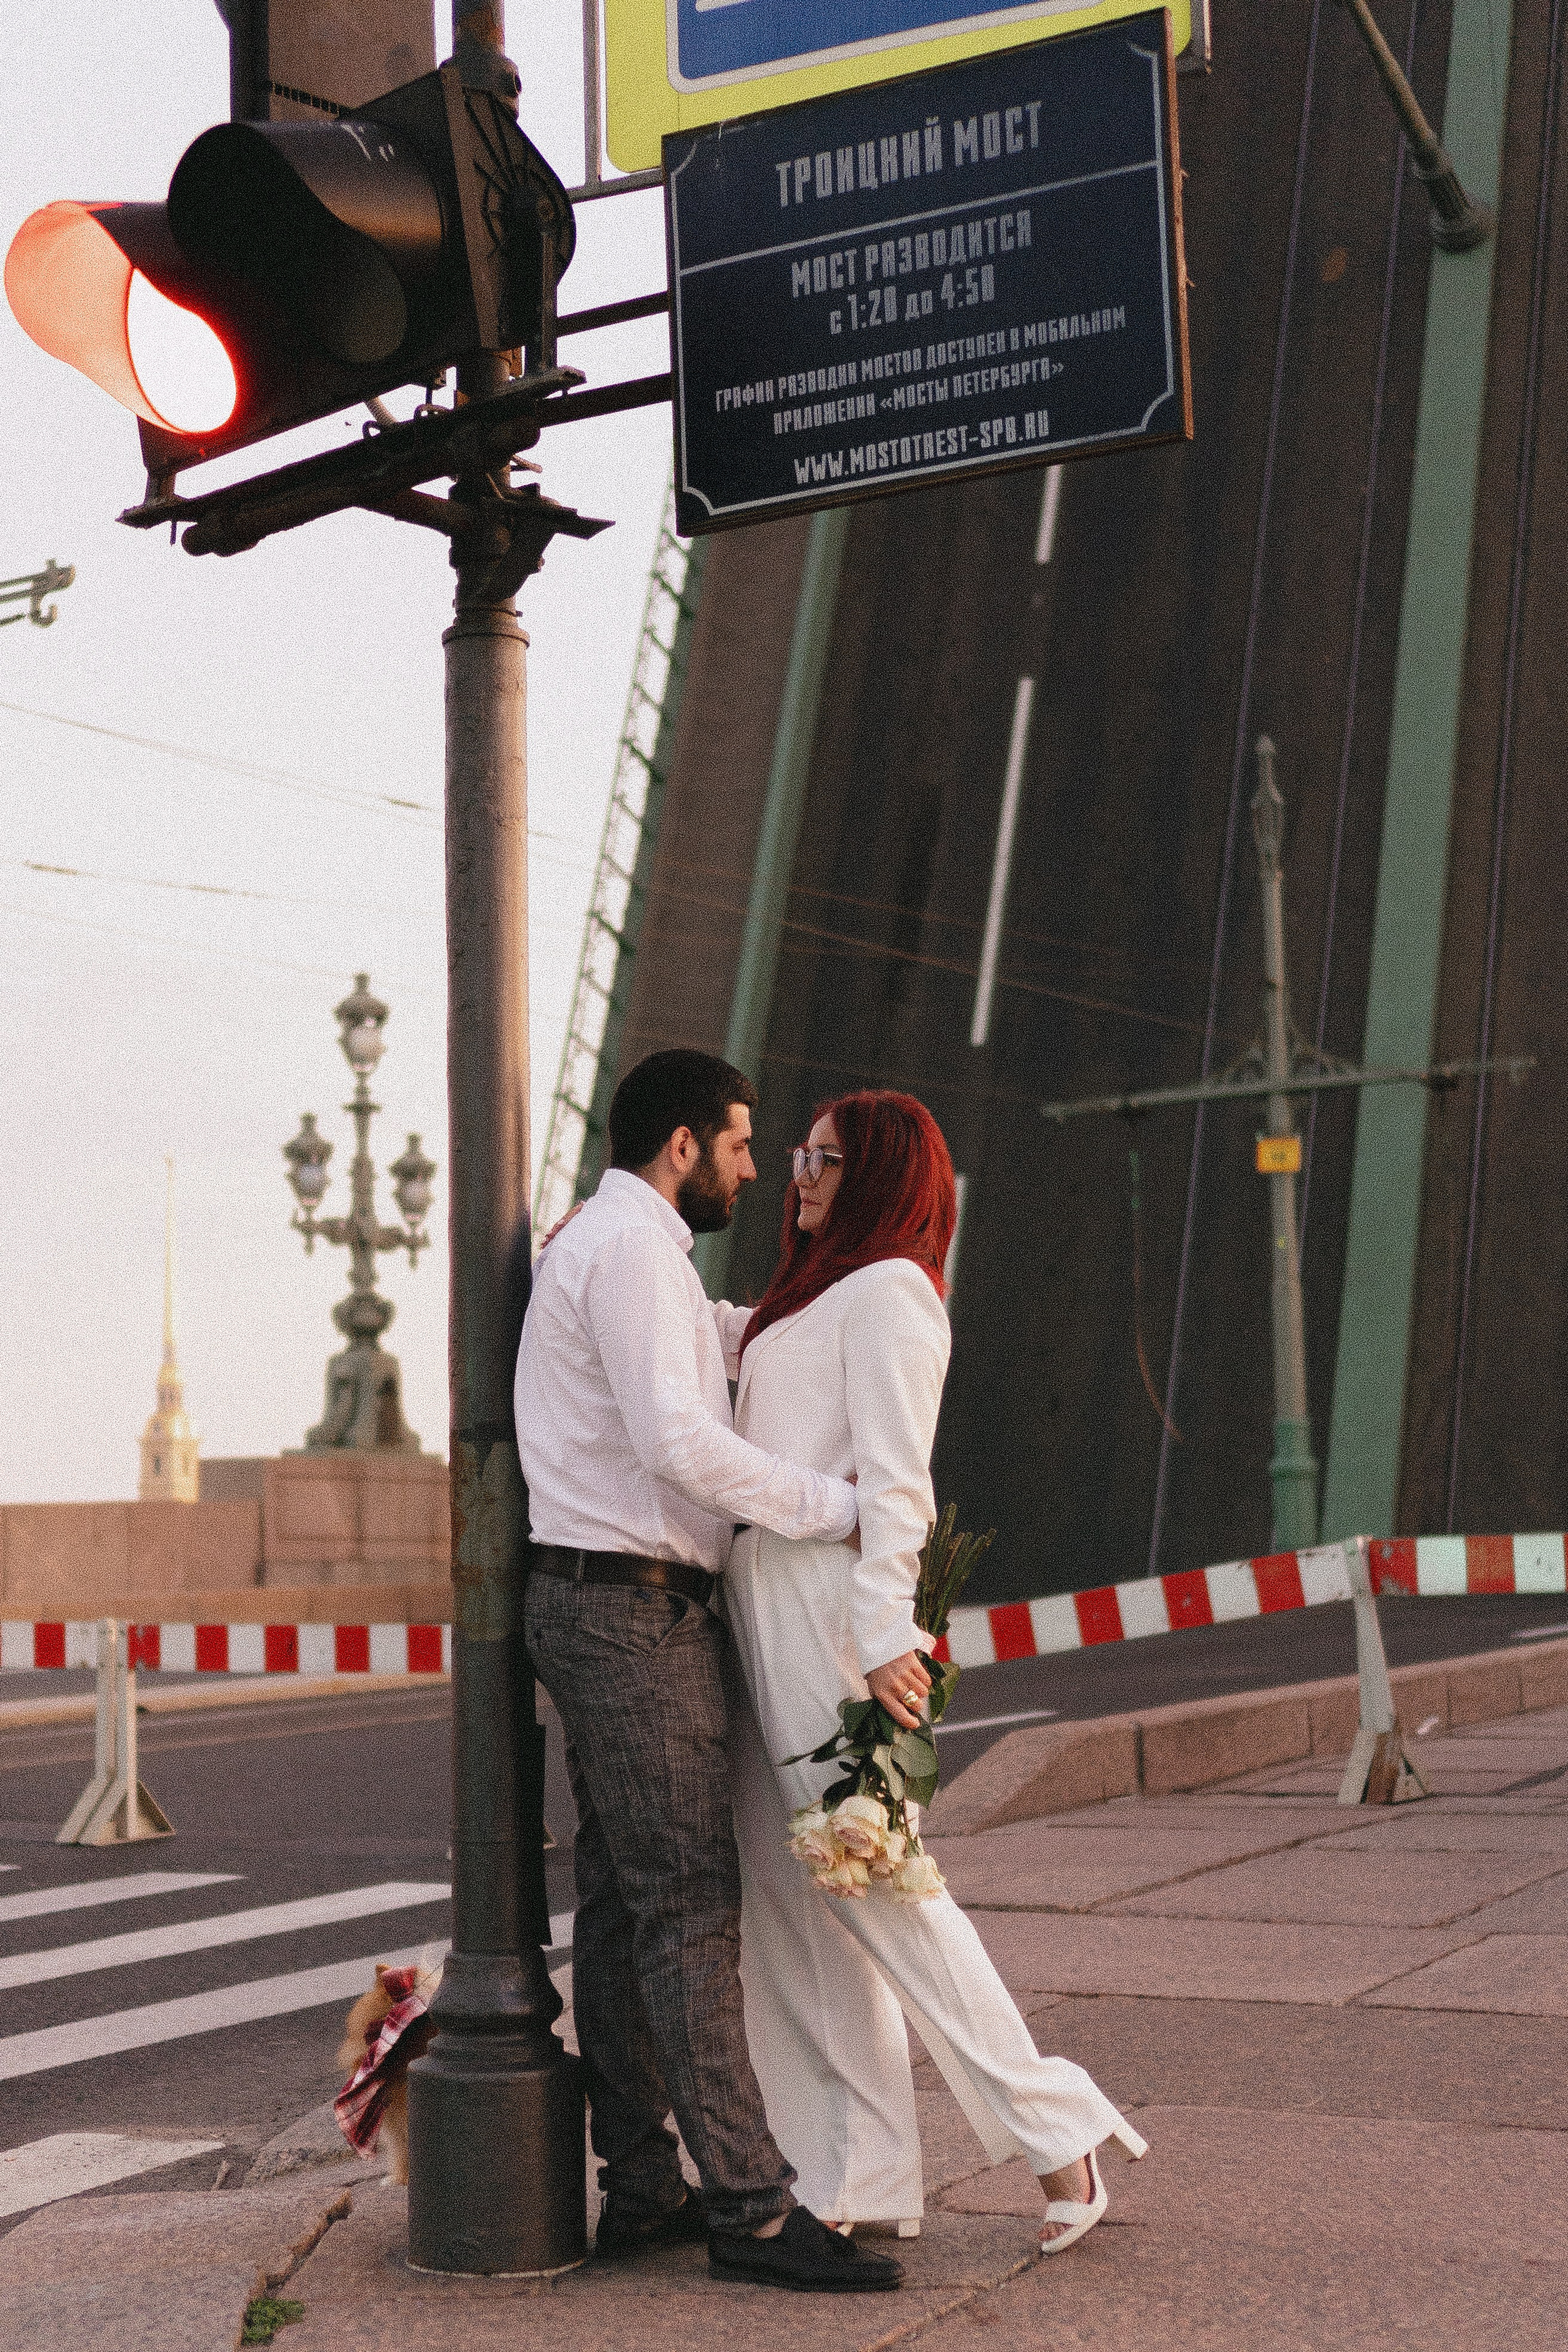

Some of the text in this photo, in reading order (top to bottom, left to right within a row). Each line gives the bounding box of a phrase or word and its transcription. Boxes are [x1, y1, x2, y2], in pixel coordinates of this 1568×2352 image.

[775, 100, 1042, 208] ТРОИЦКИЙ МОСТ
[791, 210, 1030, 298] МОСТ РАЗВОДИТСЯ
[848, 285, 897, 330] 1:20
[905, 290, 933, 321] до
[941, 264, 995, 310] 4:50
[716, 380, 774, 412] ГРАФИК
[861, 348, 921, 382] МОСТОВ
[926, 330, 1006, 370] ДОСТУПЕН
[1010, 327, 1019, 350] В
[1024, 306, 1125, 348] МОБИЛЬНОМ
[774, 356, 1065, 435] ПРИЛОЖЕНИИ «МОСТЫ ПЕТЕРБУРГА»
[794, 410, 1049, 484] WWW.MOSTOTREST-SPB.RU
